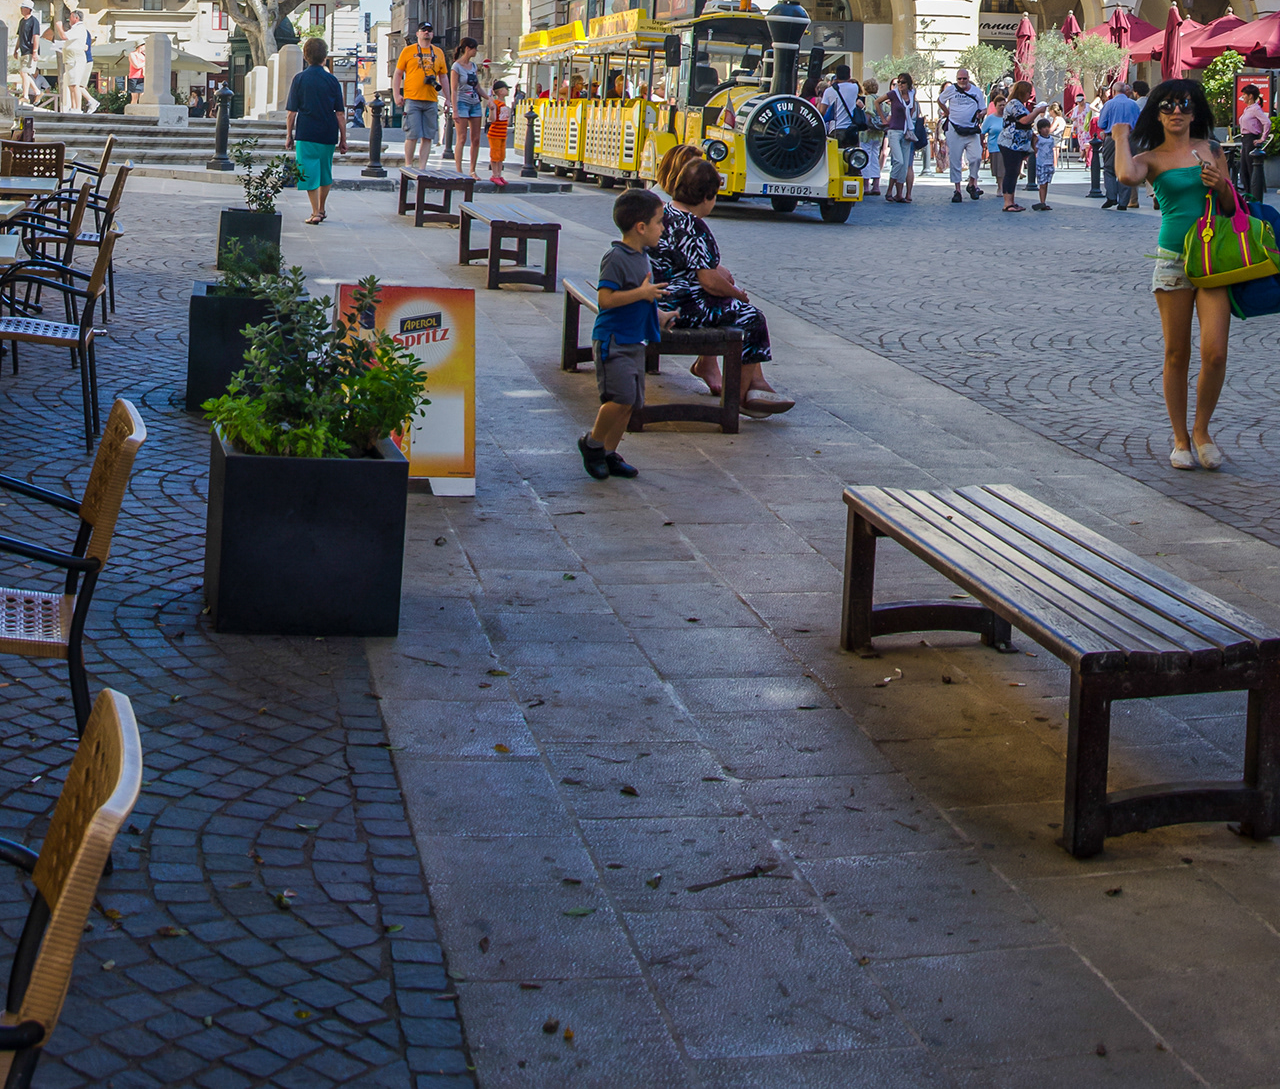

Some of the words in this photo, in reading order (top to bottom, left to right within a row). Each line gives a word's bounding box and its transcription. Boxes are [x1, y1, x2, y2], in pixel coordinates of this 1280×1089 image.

[758, 109, 773, 124] STS
[776, 102, 794, 112] FUN
[800, 106, 818, 128] TRAIN
[403, 316, 438, 332] APEROL
[392, 327, 450, 351] Spritz
